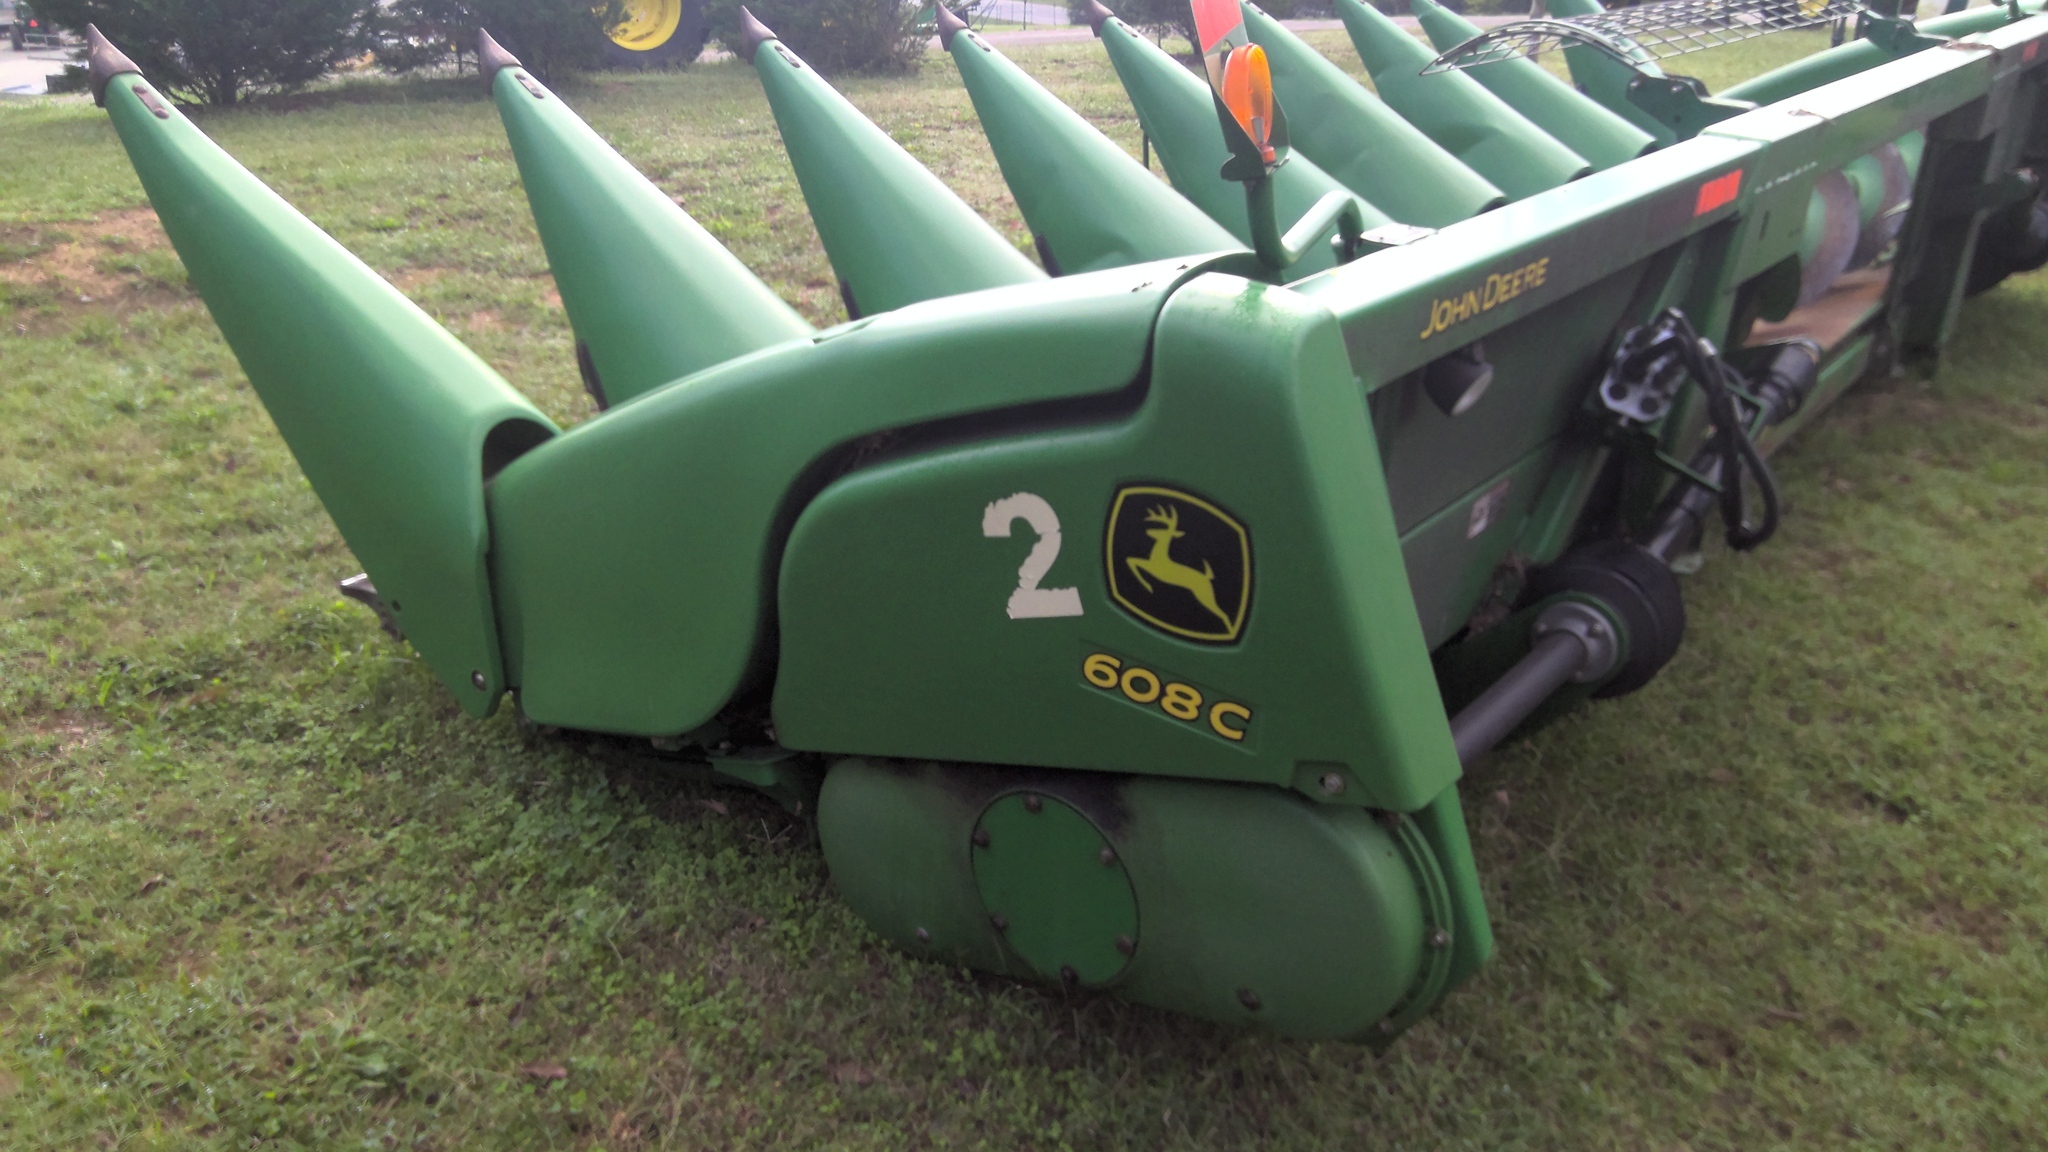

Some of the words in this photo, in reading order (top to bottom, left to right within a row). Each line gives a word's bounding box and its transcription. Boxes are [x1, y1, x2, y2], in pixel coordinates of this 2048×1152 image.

[1420, 287, 1484, 339] JOHN
[1482, 257, 1550, 311] DEERE
[982, 491, 1084, 619] 2
